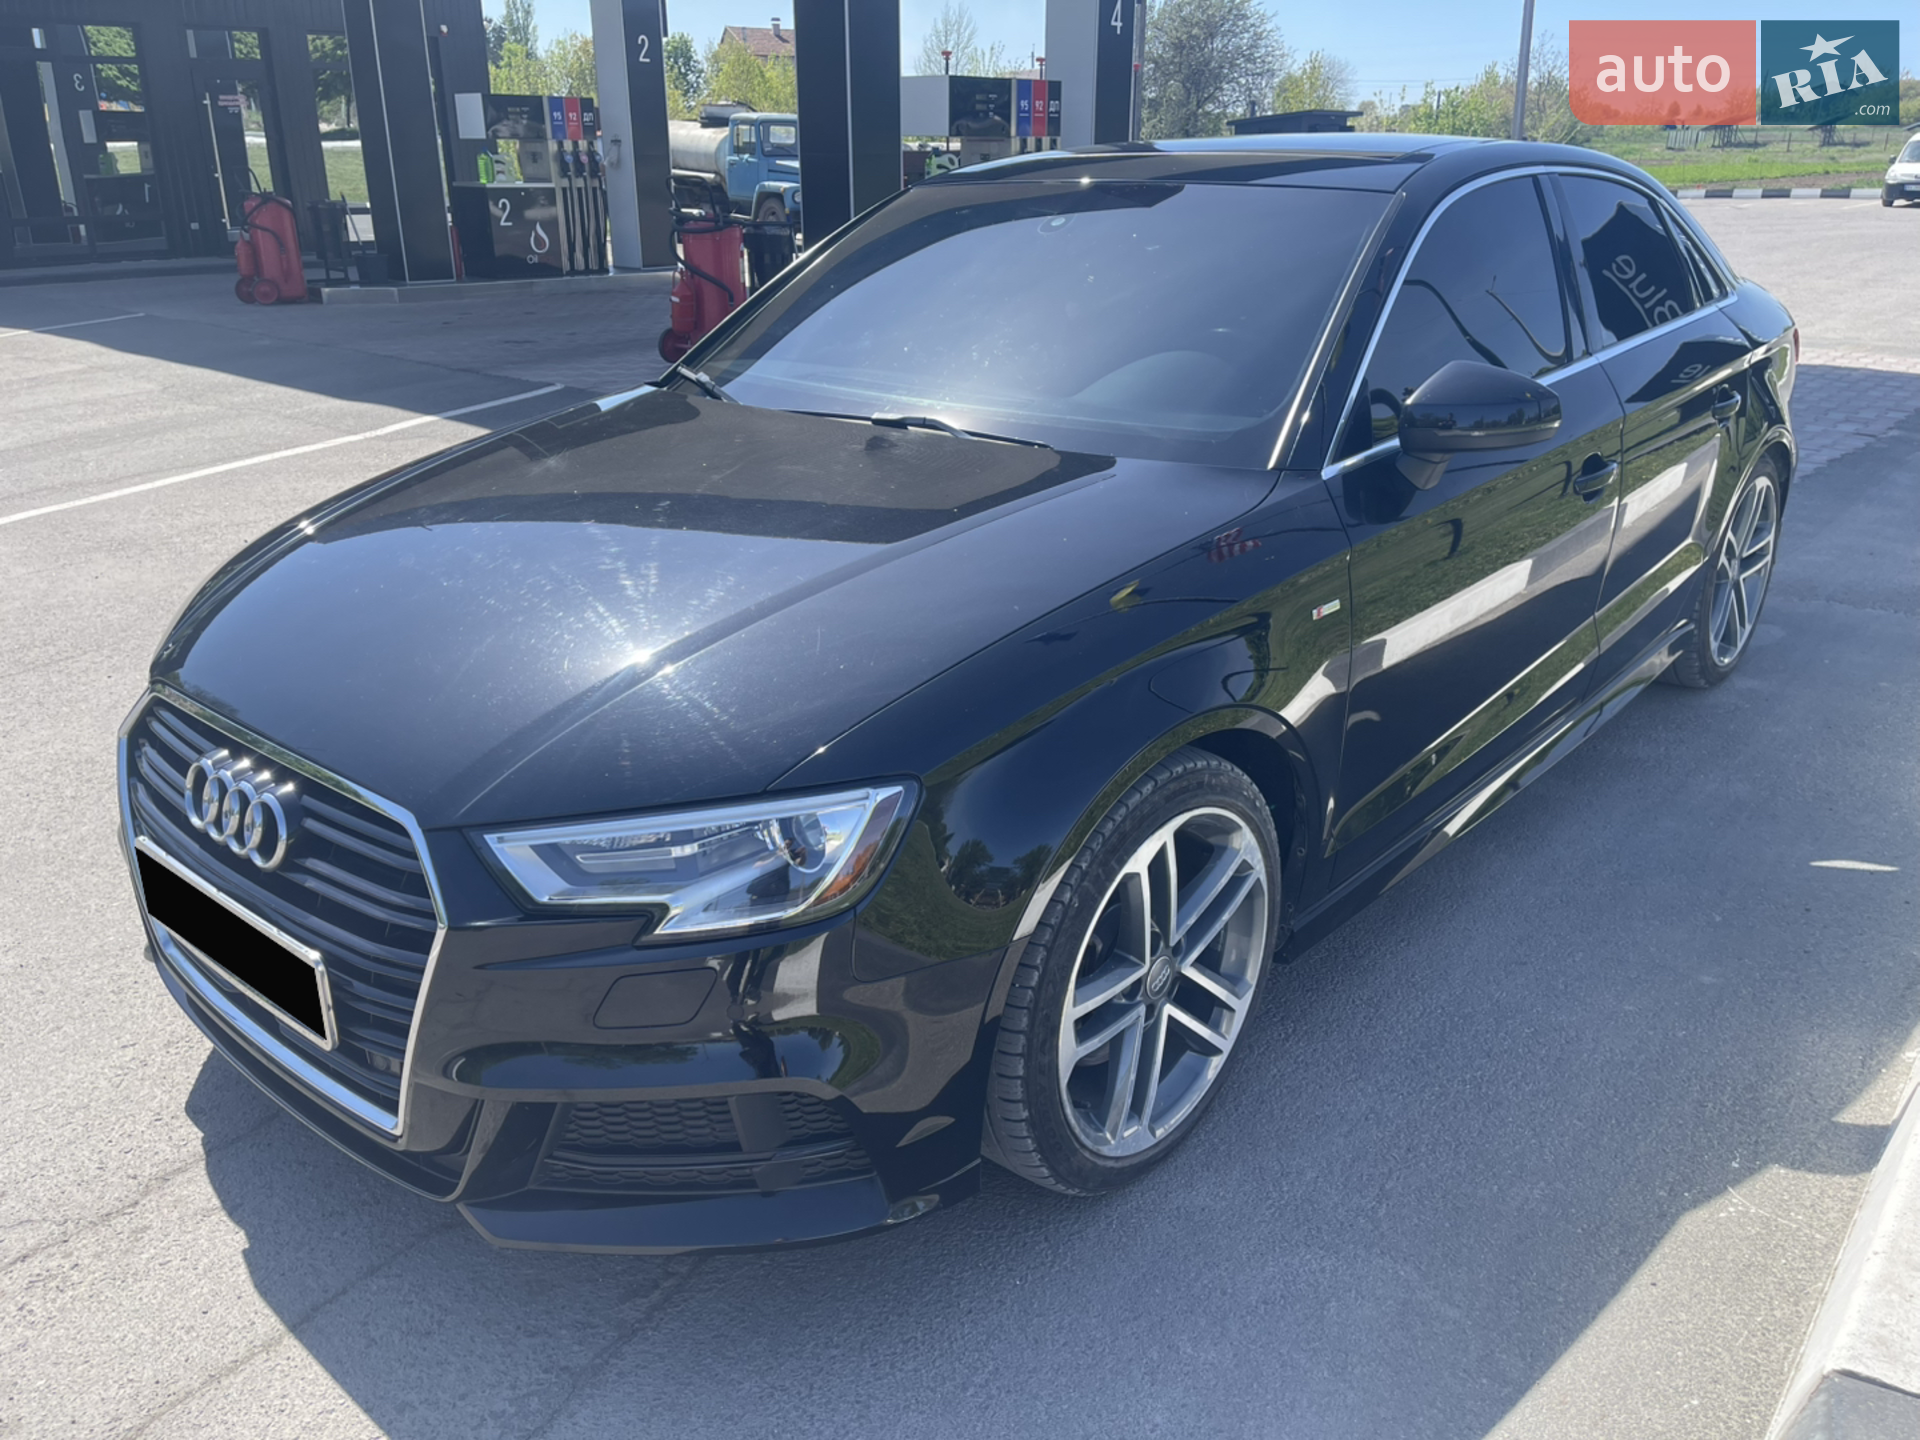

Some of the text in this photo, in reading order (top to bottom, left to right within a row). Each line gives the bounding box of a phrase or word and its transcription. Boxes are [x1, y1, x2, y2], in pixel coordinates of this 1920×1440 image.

[1110, 0, 1123, 35] 4
[637, 34, 651, 63] 2
[1020, 99, 1029, 111] 95
[1035, 100, 1044, 111] 92
[1048, 100, 1060, 112] ДП
[552, 111, 562, 121] 95
[568, 111, 577, 121] 92
[583, 112, 594, 122] ДП
[497, 198, 513, 227] 2
